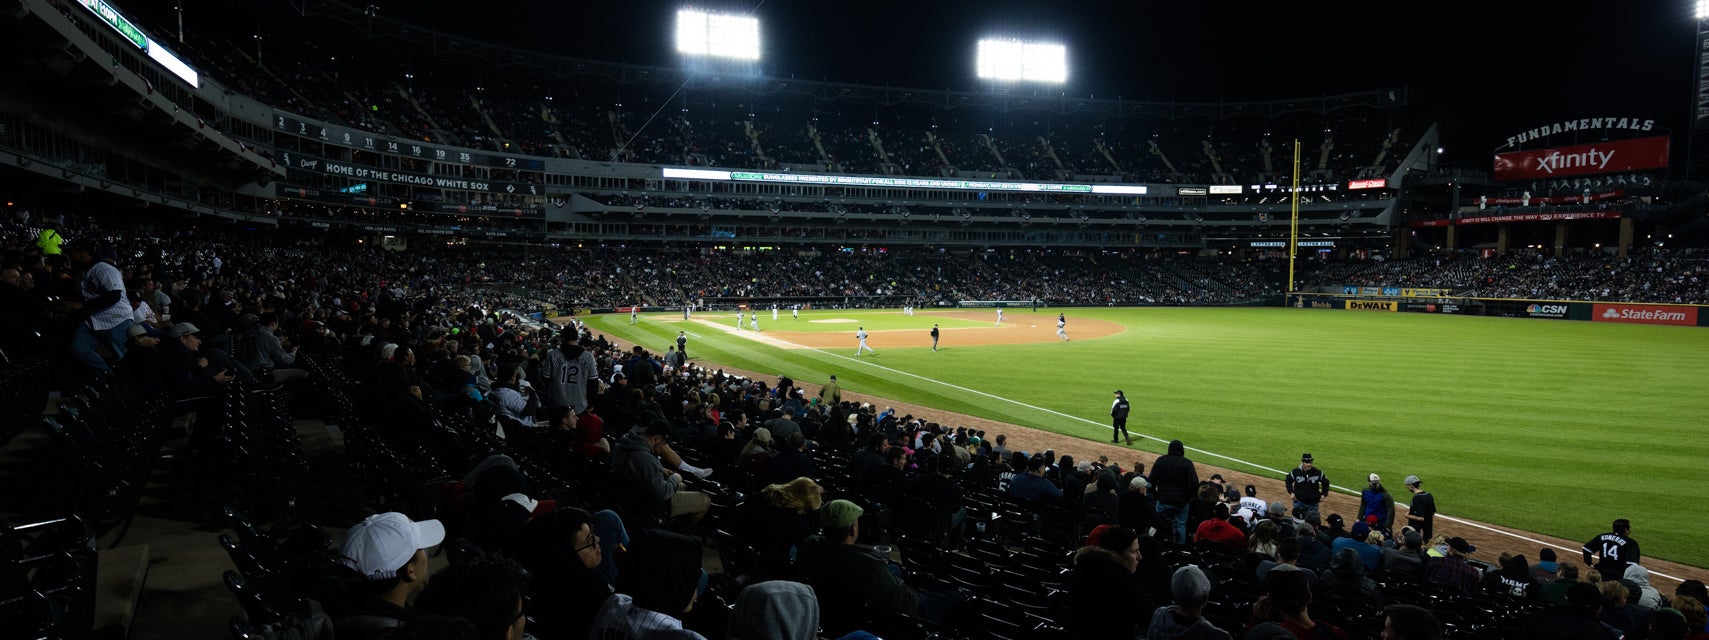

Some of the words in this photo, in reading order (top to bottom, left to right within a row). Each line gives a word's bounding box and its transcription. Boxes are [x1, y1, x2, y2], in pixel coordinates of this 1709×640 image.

[279, 117, 284, 126] 2
[300, 122, 306, 131] 3
[320, 128, 326, 137] 4
[1507, 117, 1654, 148] FUNDAMENTALS
[344, 133, 350, 142] 9
[366, 138, 373, 146] 11
[388, 142, 398, 150] 14
[412, 146, 421, 154] 16
[460, 152, 470, 160] 35
[506, 158, 516, 166] 72
[1536, 148, 1616, 174] xfinity
[326, 163, 353, 175] HOME
[356, 168, 368, 177] OF
[371, 170, 389, 180] THE
[392, 173, 433, 186] CHICAGO
[436, 178, 468, 189] WHITE
[470, 182, 489, 191] SOX
[1312, 301, 1332, 309] Modelo
[1541, 305, 1568, 314] CSN
[560, 364, 579, 385] 12
[1601, 534, 1627, 547] KONERKO
[1602, 542, 1619, 561] 14
